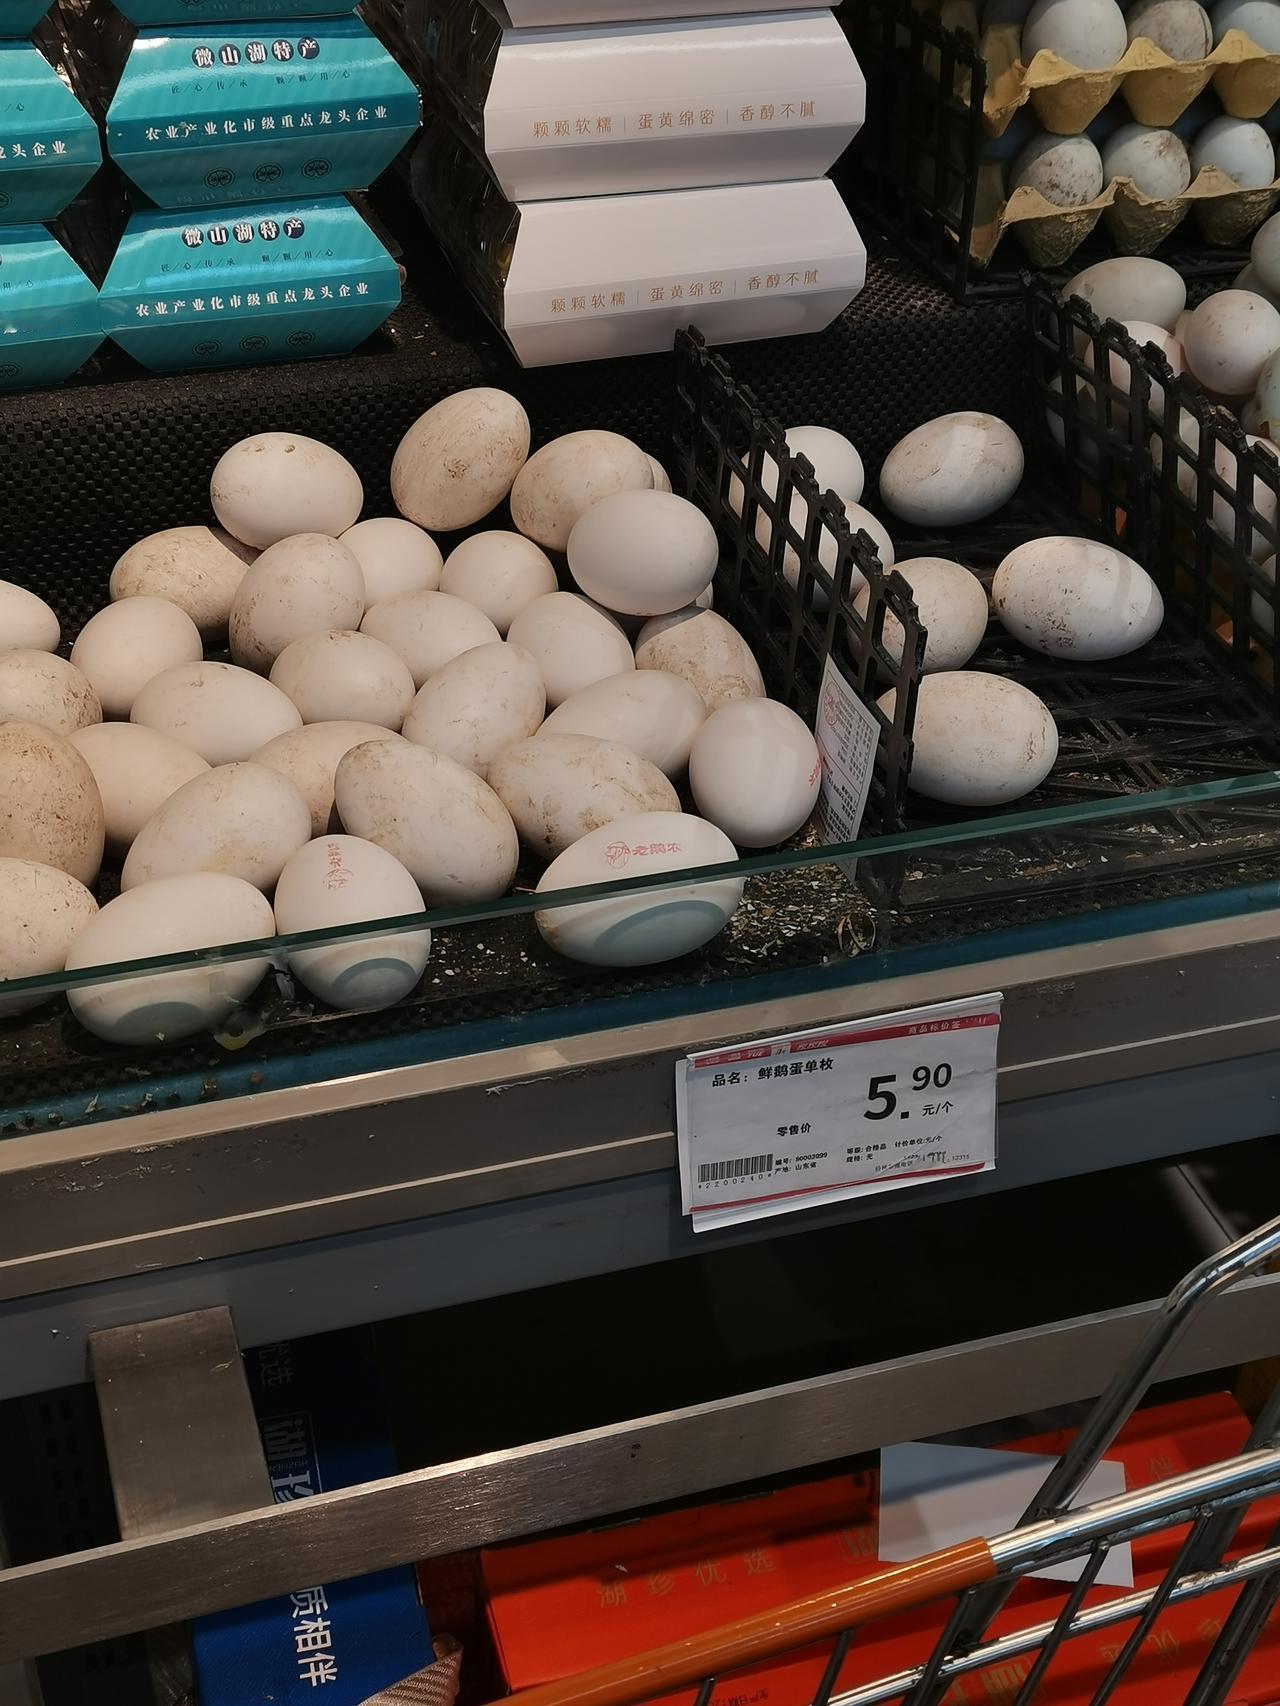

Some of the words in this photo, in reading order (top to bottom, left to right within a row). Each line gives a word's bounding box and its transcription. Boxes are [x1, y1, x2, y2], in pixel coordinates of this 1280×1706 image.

[194, 38, 318, 67] 微山湖特产
[145, 105, 388, 140] 农业产业化市级重点龙头企业
[533, 115, 612, 138] 颗颗软糯
[638, 109, 716, 130] 蛋黄绵密
[739, 100, 817, 123] 香醇不腻
[183, 218, 305, 247] 微山湖特产
[136, 281, 370, 317] 农业产业化市级重点龙头企业
[550, 291, 626, 313] 颗颗软糯
[650, 280, 724, 302] 蛋黄绵密
[747, 269, 820, 291] 香醇不腻
[757, 1057, 834, 1081] 鲜鹅蛋单枚
[922, 1100, 954, 1117] 元/个
[776, 1122, 812, 1137] 零售价
[289, 1584, 339, 1688] 质相伴
